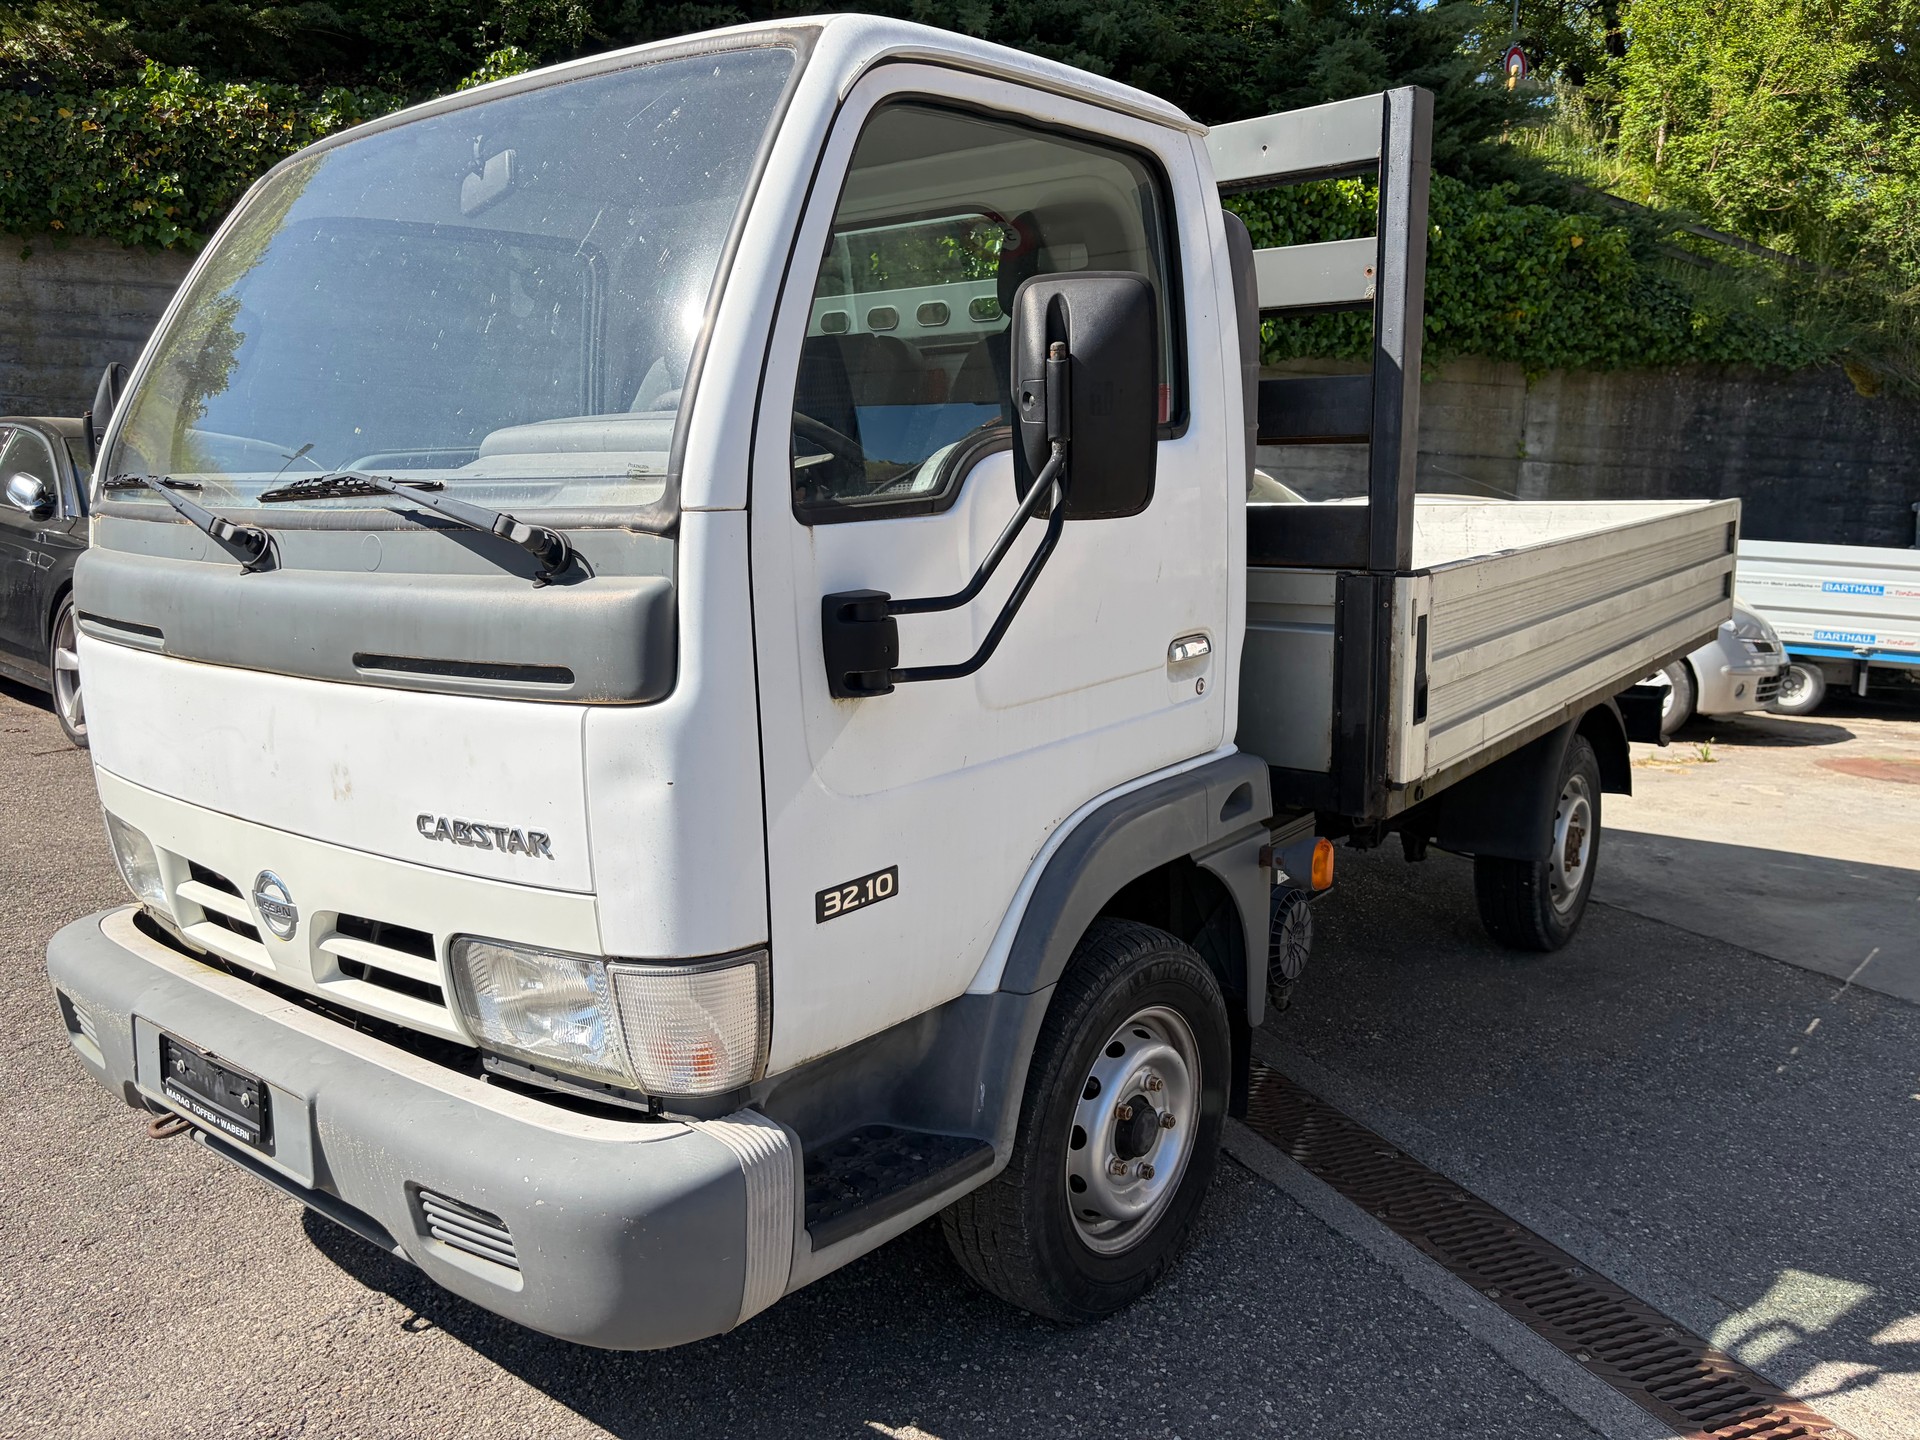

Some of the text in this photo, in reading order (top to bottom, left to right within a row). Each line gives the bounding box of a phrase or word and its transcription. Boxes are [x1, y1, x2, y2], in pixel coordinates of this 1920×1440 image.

[416, 813, 555, 860] CABSTAR
[823, 873, 893, 917] 32.10
[166, 1088, 191, 1108] MARAG
[192, 1103, 216, 1123] TOFFEN
[220, 1118, 250, 1140] WABERN
